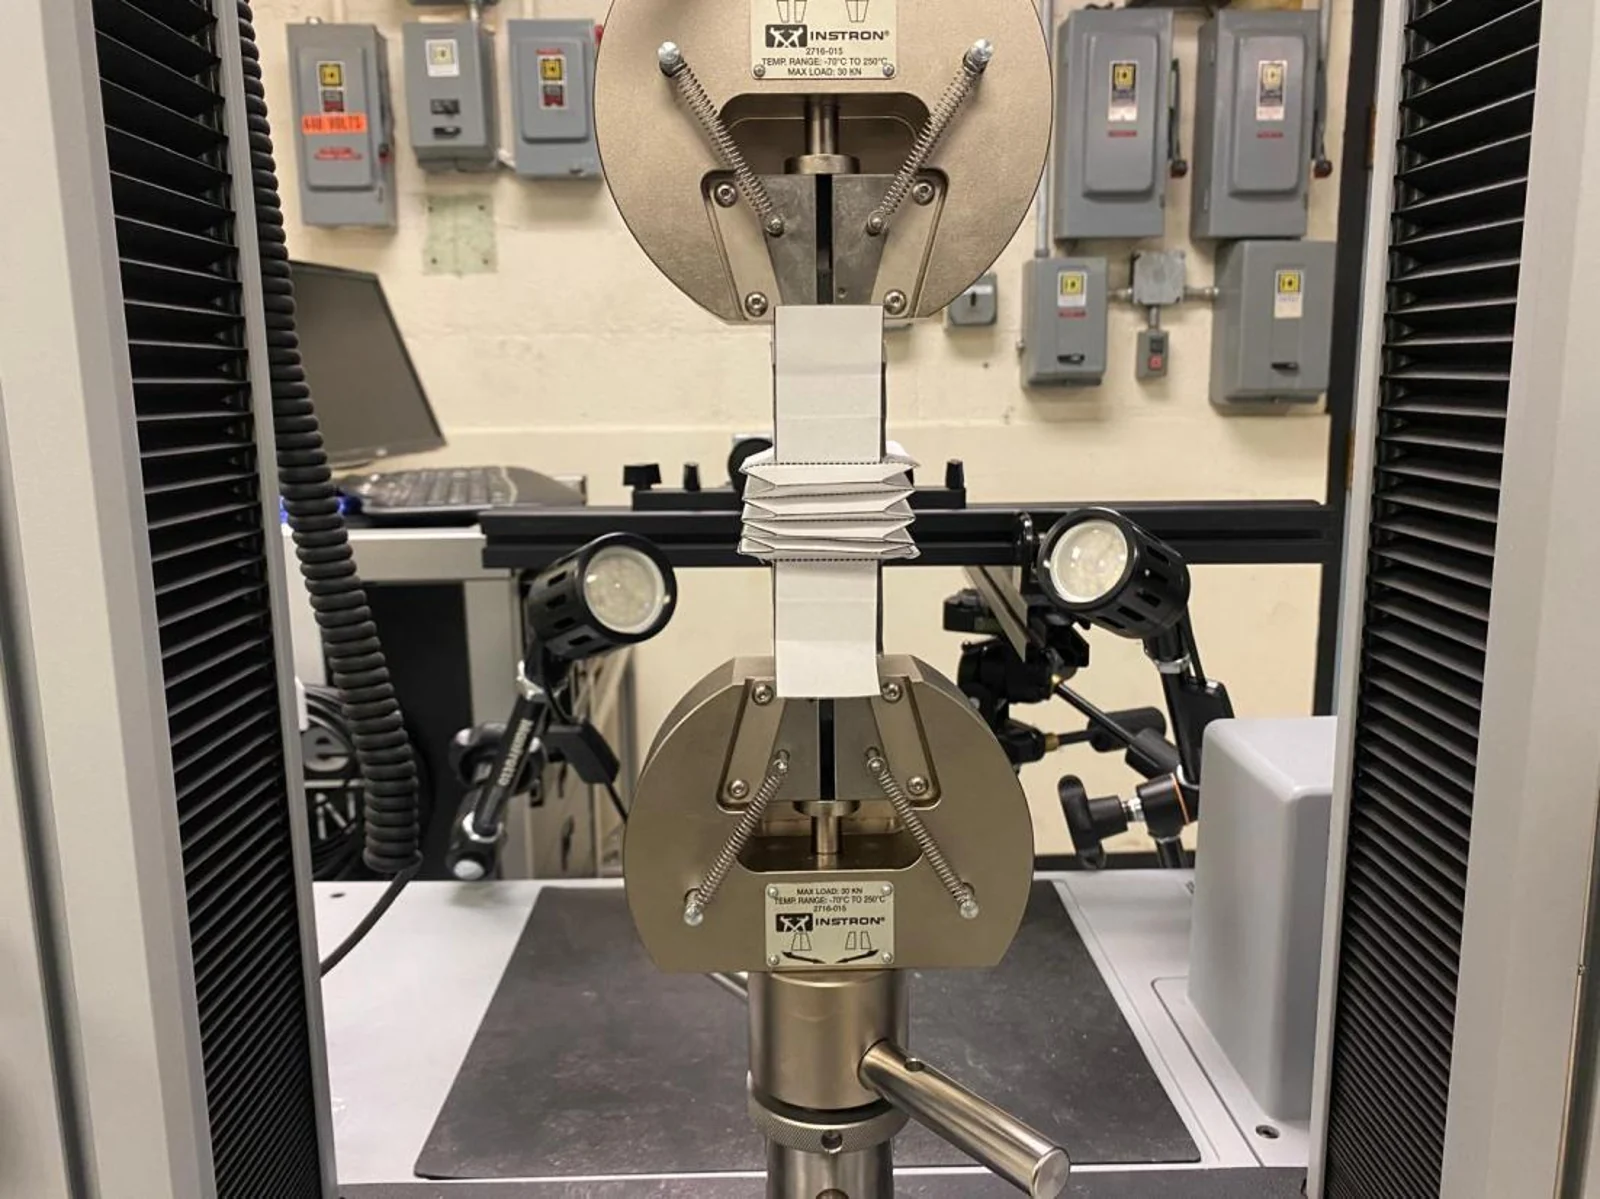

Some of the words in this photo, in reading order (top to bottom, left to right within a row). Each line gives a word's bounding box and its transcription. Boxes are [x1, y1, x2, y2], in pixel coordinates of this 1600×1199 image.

[805, 47, 844, 56] 2716-015
[762, 57, 788, 66] TEMP.
[789, 57, 822, 66] RANGE:
[824, 57, 848, 66] -70°C
[850, 57, 862, 66] TO
[863, 57, 888, 66] 250°C
[788, 67, 807, 76] MAX
[809, 67, 835, 76] LOAD:
[837, 67, 848, 76] 30
[849, 67, 862, 76] KN
[815, 887, 839, 895] LOAD:
[841, 887, 851, 895] 30
[797, 896, 828, 904] RANGE:
[829, 896, 850, 904] -70°C
[851, 896, 862, 904] TO
[863, 895, 886, 904] 250°C
